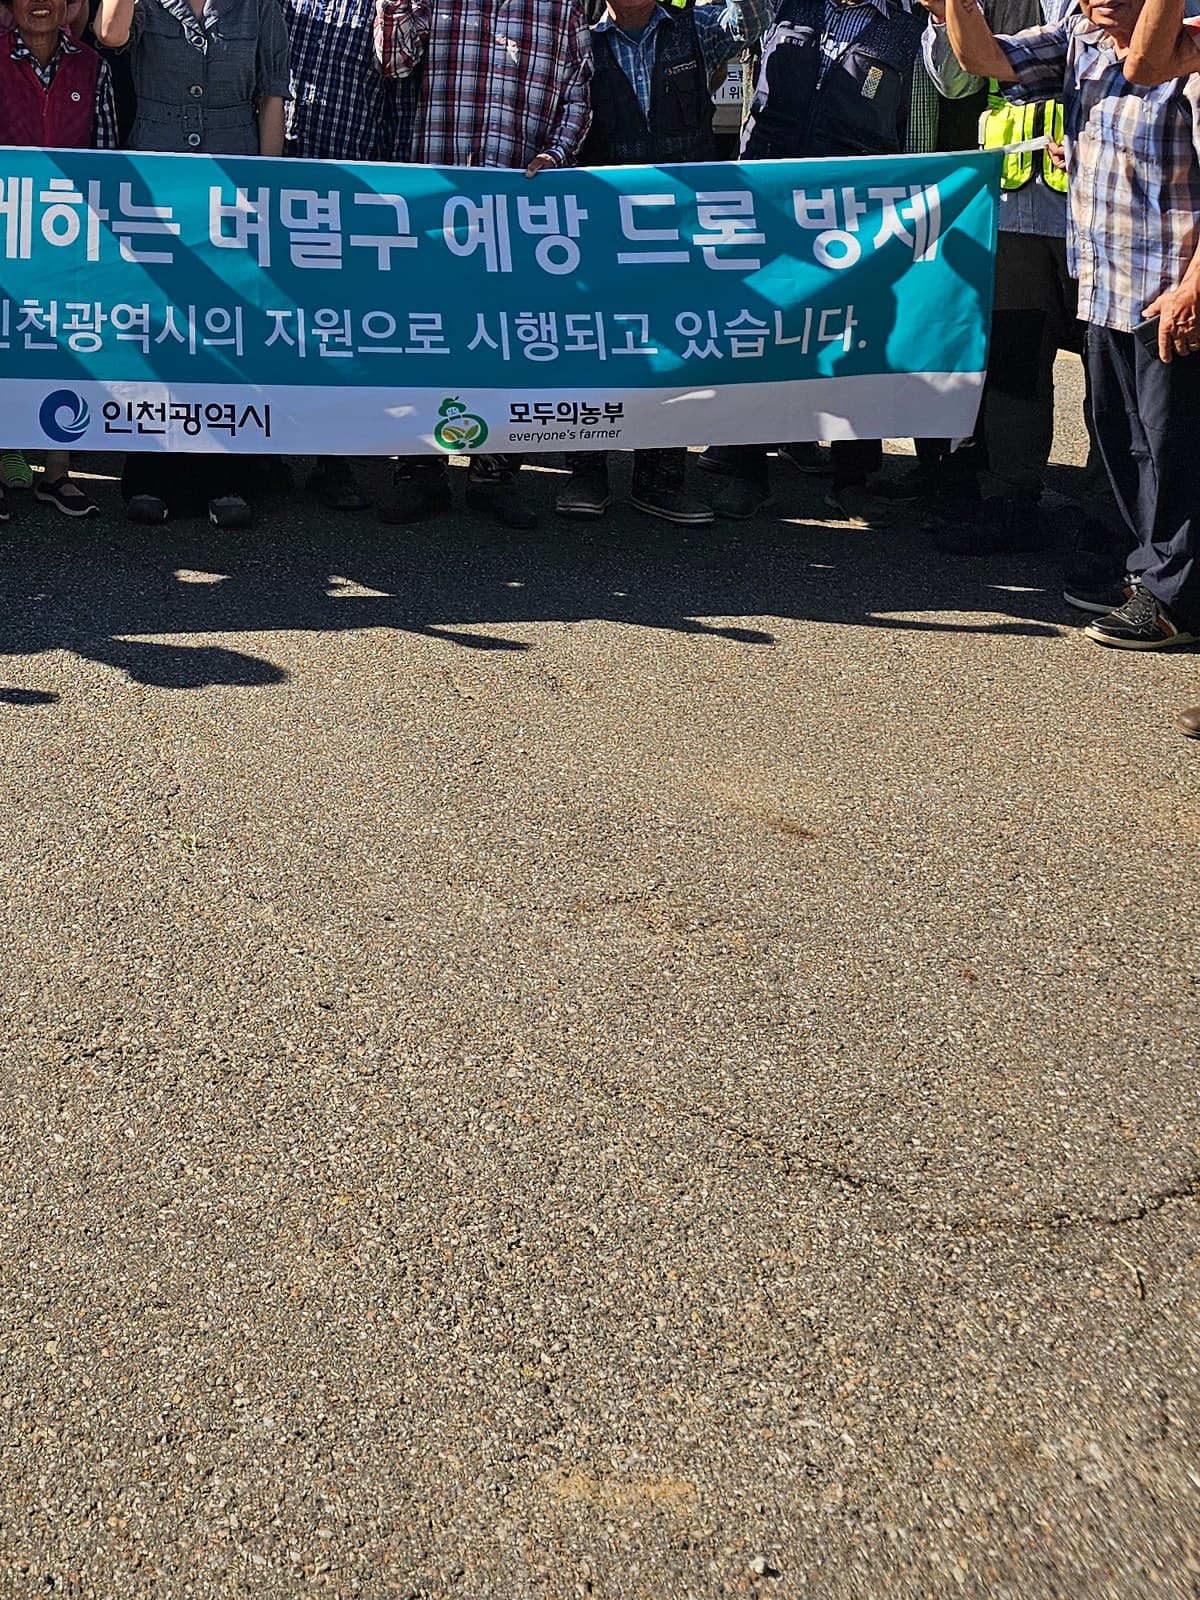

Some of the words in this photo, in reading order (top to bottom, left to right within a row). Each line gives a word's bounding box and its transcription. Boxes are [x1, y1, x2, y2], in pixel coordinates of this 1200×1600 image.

[209, 186, 418, 271] 벼멸구
[443, 194, 588, 275] 예방
[617, 190, 765, 270] 드론
[793, 184, 941, 270] 방제
[265, 308, 450, 358] 지원으로
[467, 311, 658, 361] 시행되고
[675, 304, 867, 359] 있습니다.
[102, 401, 271, 437] 인천광역시
[509, 402, 625, 426] 모두의농부
[509, 429, 576, 443] everyone's
[579, 428, 622, 440] farmer
